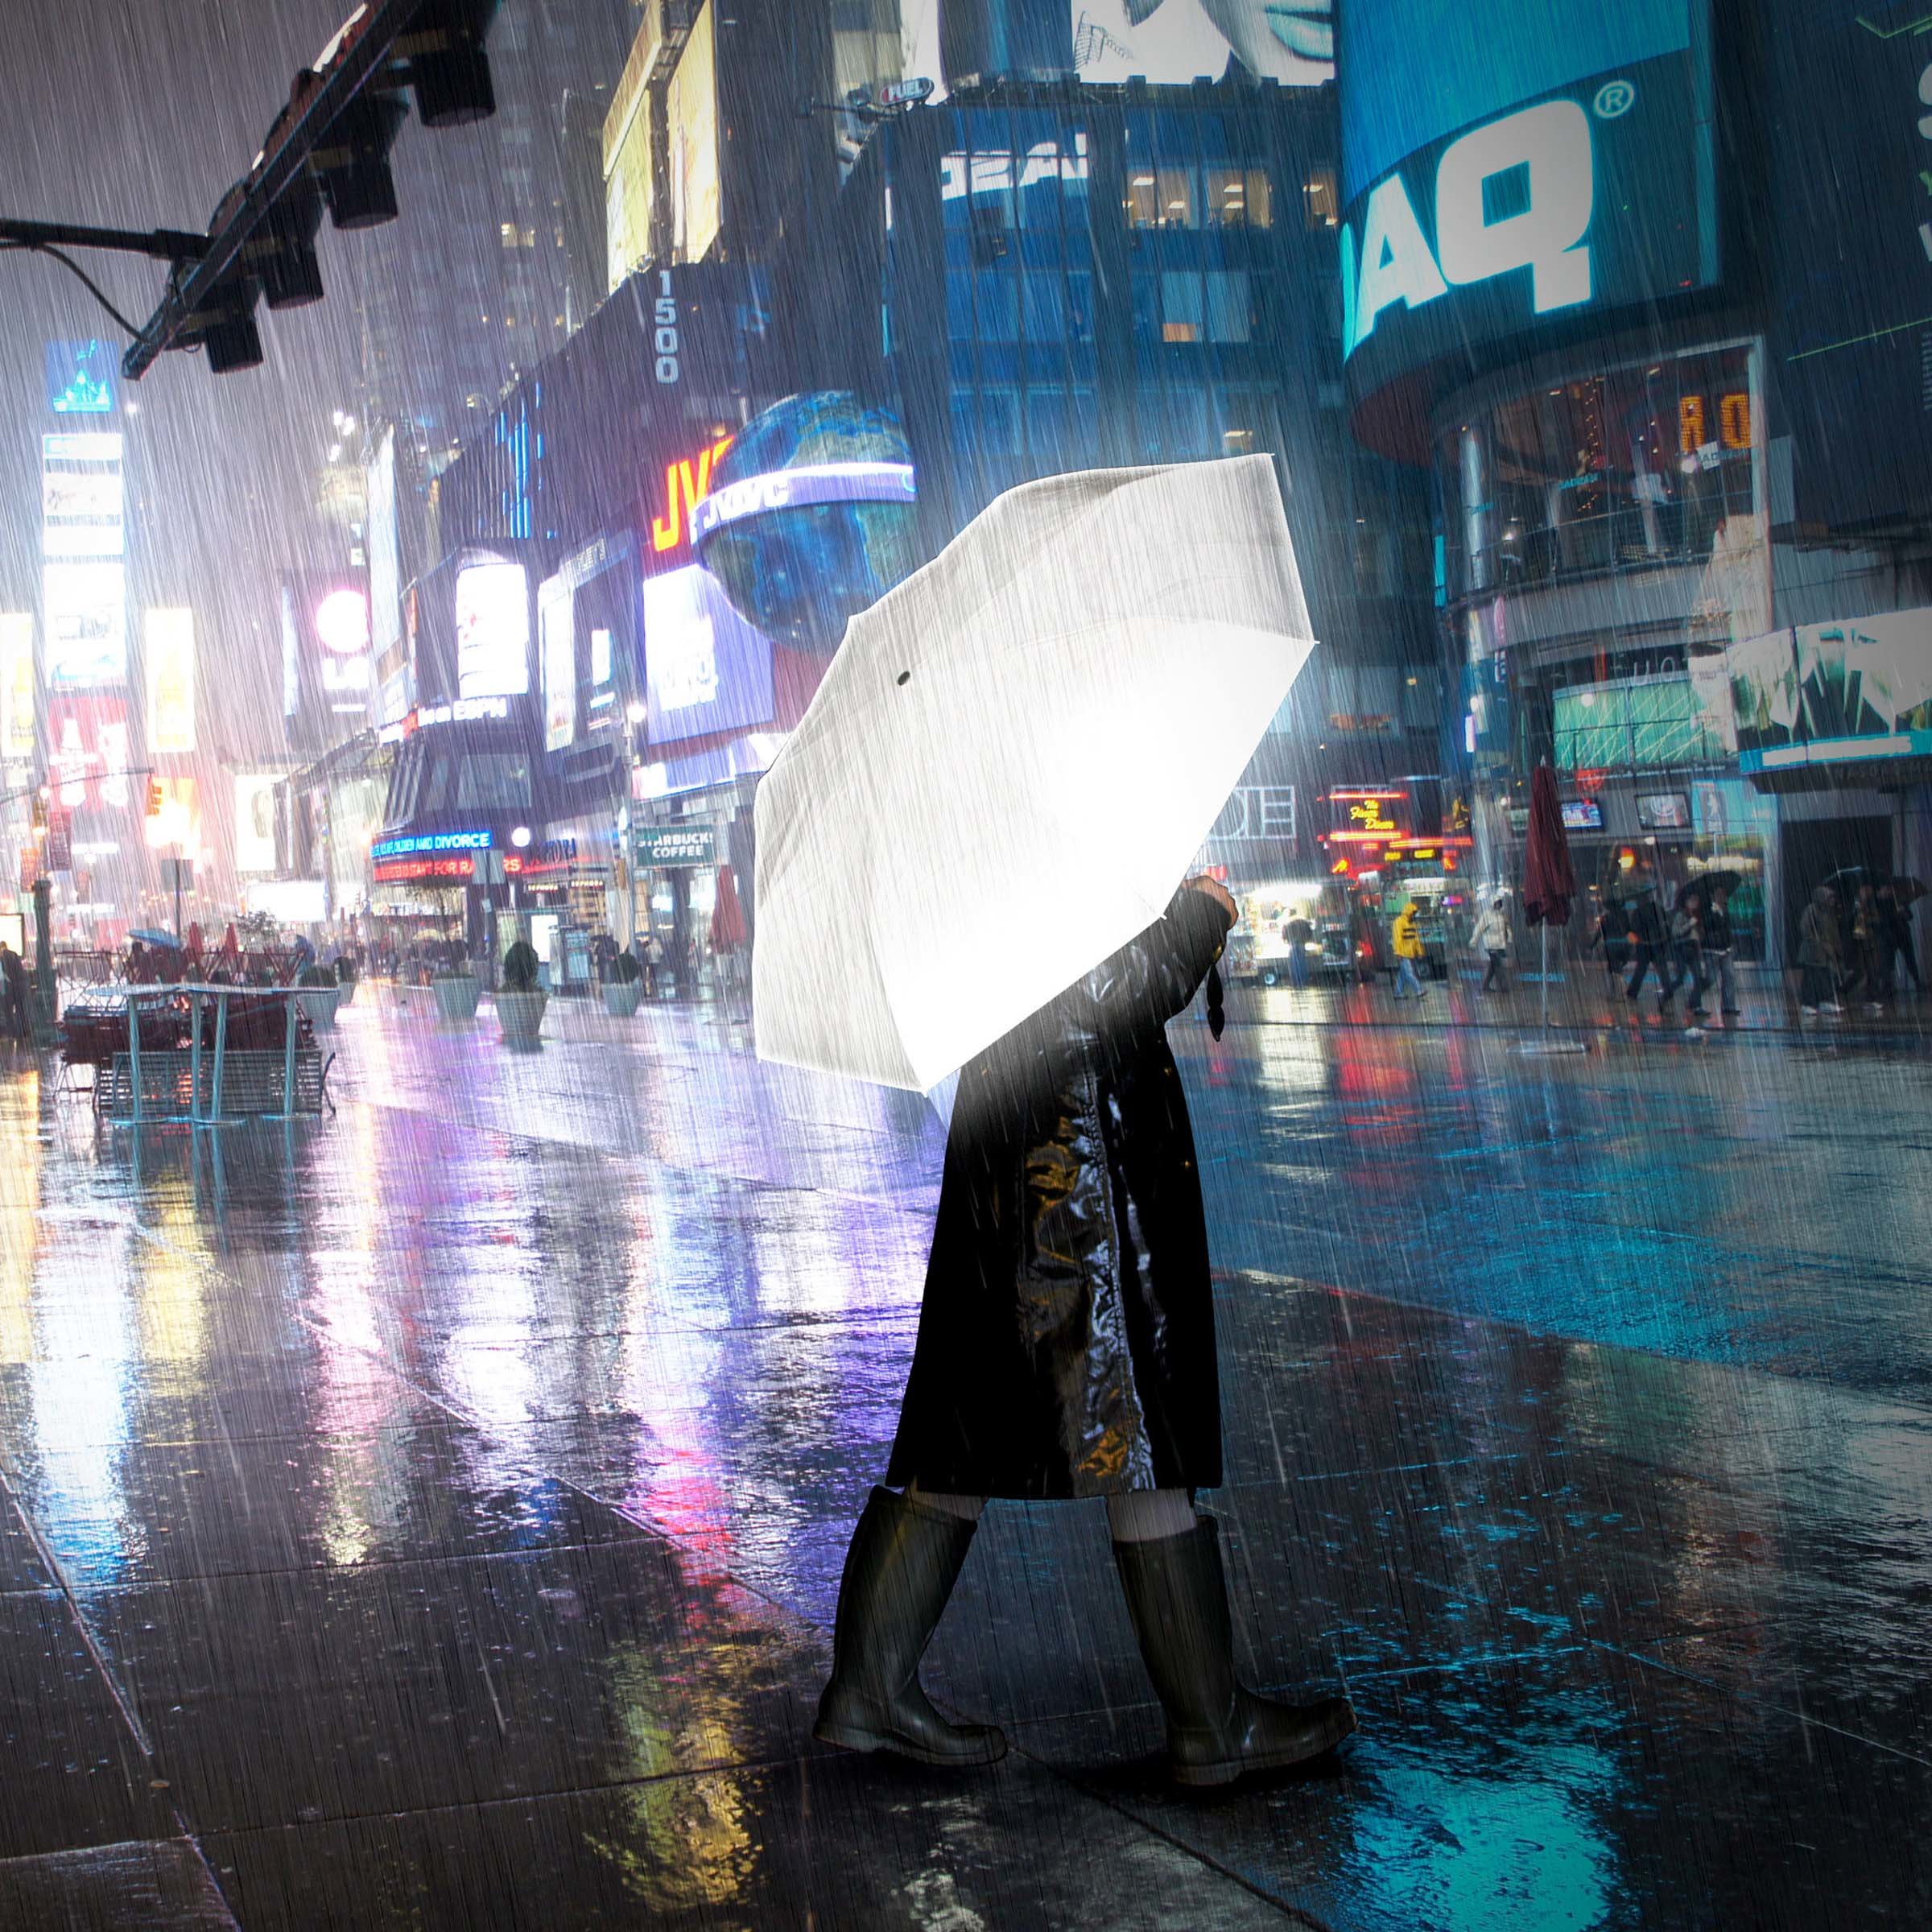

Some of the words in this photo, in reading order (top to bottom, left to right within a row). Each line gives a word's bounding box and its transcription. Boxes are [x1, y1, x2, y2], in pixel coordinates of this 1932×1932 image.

[1341, 99, 1593, 362] AQ
[654, 270, 679, 385] 1500
[435, 832, 490, 848] DIVORCE
[652, 844, 704, 859] COFFEE
